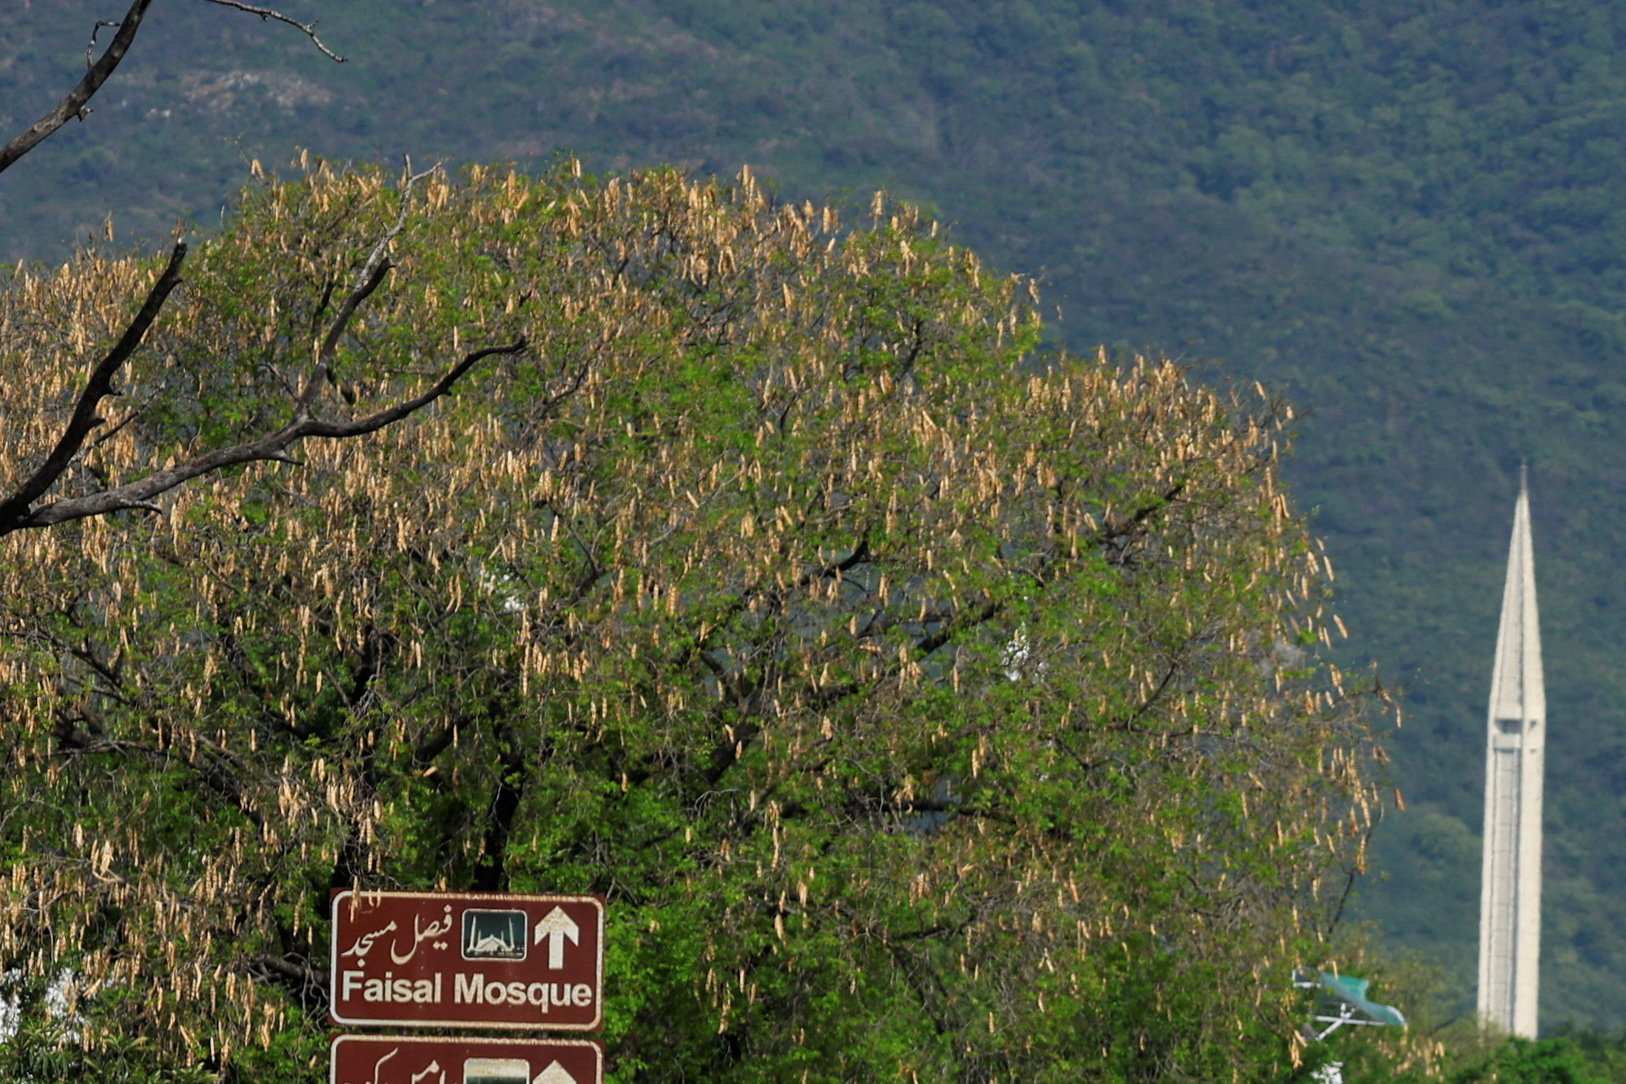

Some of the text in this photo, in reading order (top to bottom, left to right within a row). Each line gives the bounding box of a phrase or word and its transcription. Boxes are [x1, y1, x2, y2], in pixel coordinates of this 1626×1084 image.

[341, 903, 453, 968] فیصل مسجد
[342, 970, 593, 1014] Faisal Mosque
